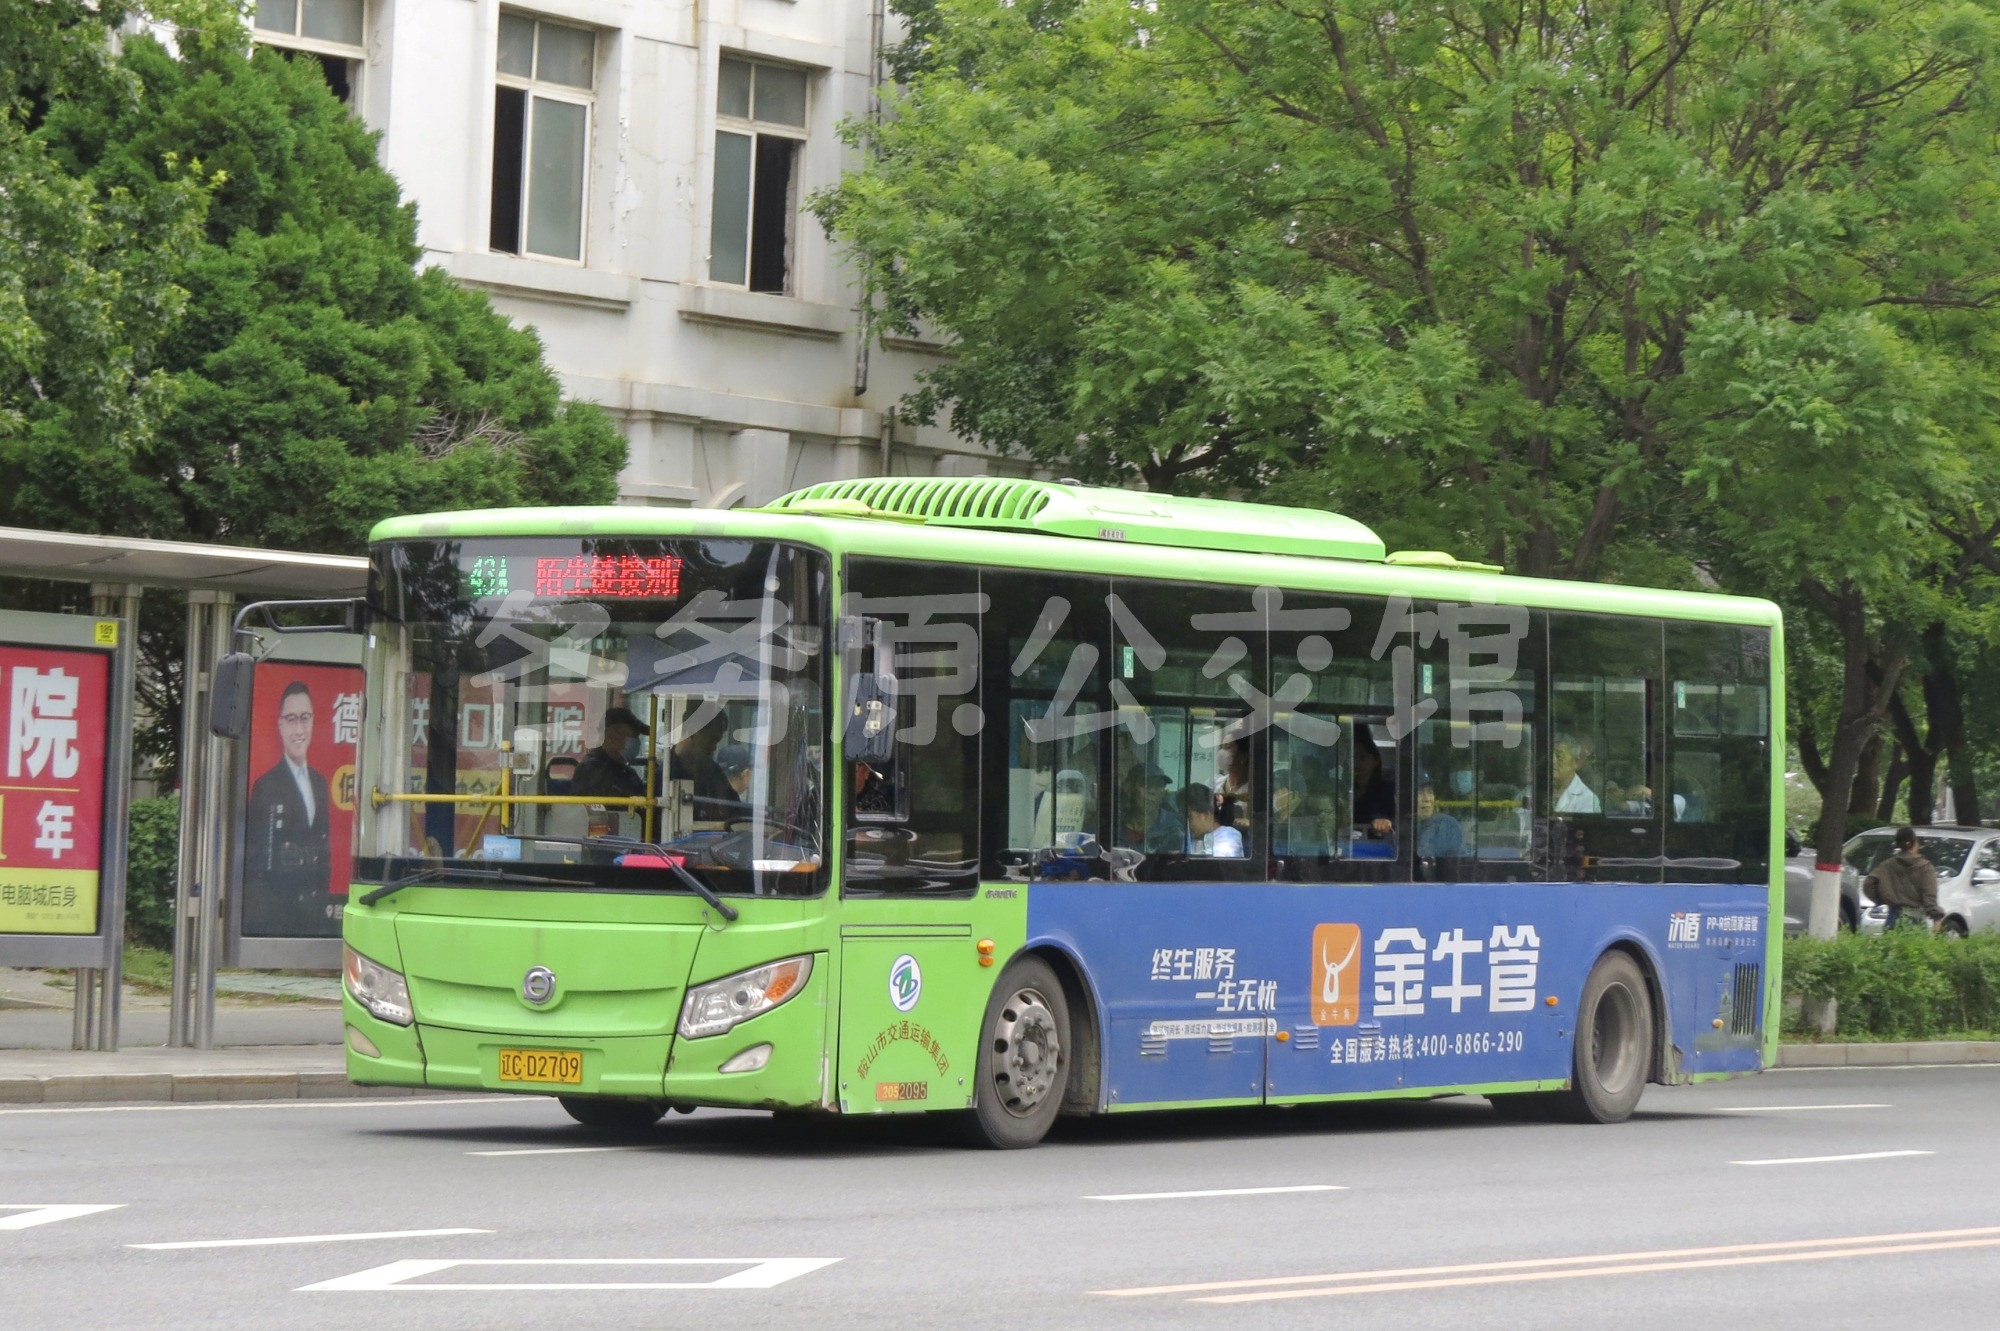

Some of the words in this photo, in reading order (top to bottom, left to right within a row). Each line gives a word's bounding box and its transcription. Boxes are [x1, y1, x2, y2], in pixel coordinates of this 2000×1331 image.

[7, 666, 80, 779] 院
[35, 800, 75, 860] 年
[1151, 947, 1236, 981] 终生服务
[1372, 924, 1541, 1017] 金牛管
[1195, 979, 1278, 1012] 一生无忧
[857, 1020, 950, 1080] 鞍山市交通运输集团
[899, 1081, 927, 1100] 2095
